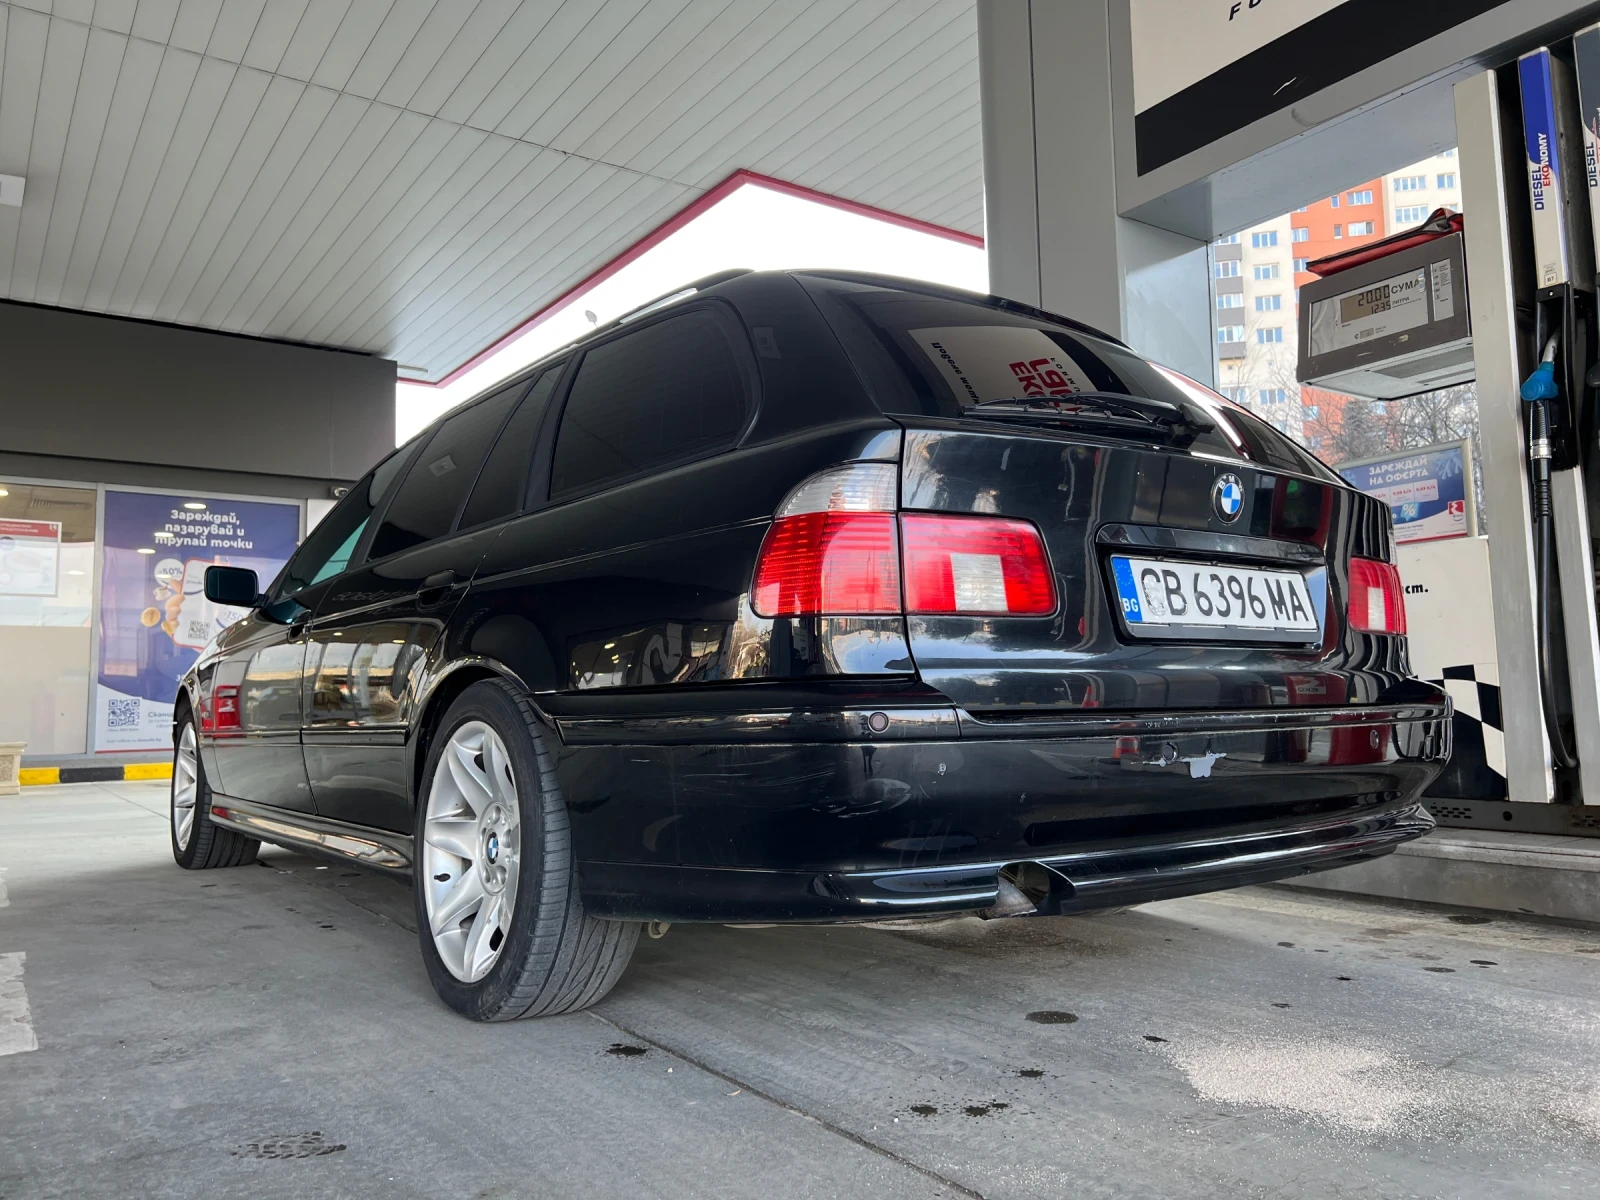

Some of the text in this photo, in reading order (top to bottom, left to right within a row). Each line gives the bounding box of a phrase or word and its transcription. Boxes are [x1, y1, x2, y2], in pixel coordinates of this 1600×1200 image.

[1538, 132, 1551, 187] EKONOMY
[1586, 141, 1599, 188] DIESEL
[1532, 166, 1545, 211] DIESEL
[1391, 279, 1420, 294] СУМА
[1369, 476, 1385, 486] НА
[171, 510, 240, 525] Зареждай,
[165, 523, 245, 537] пазарувай и
[155, 535, 253, 549] трупай точки
[1123, 597, 1139, 613] BG
